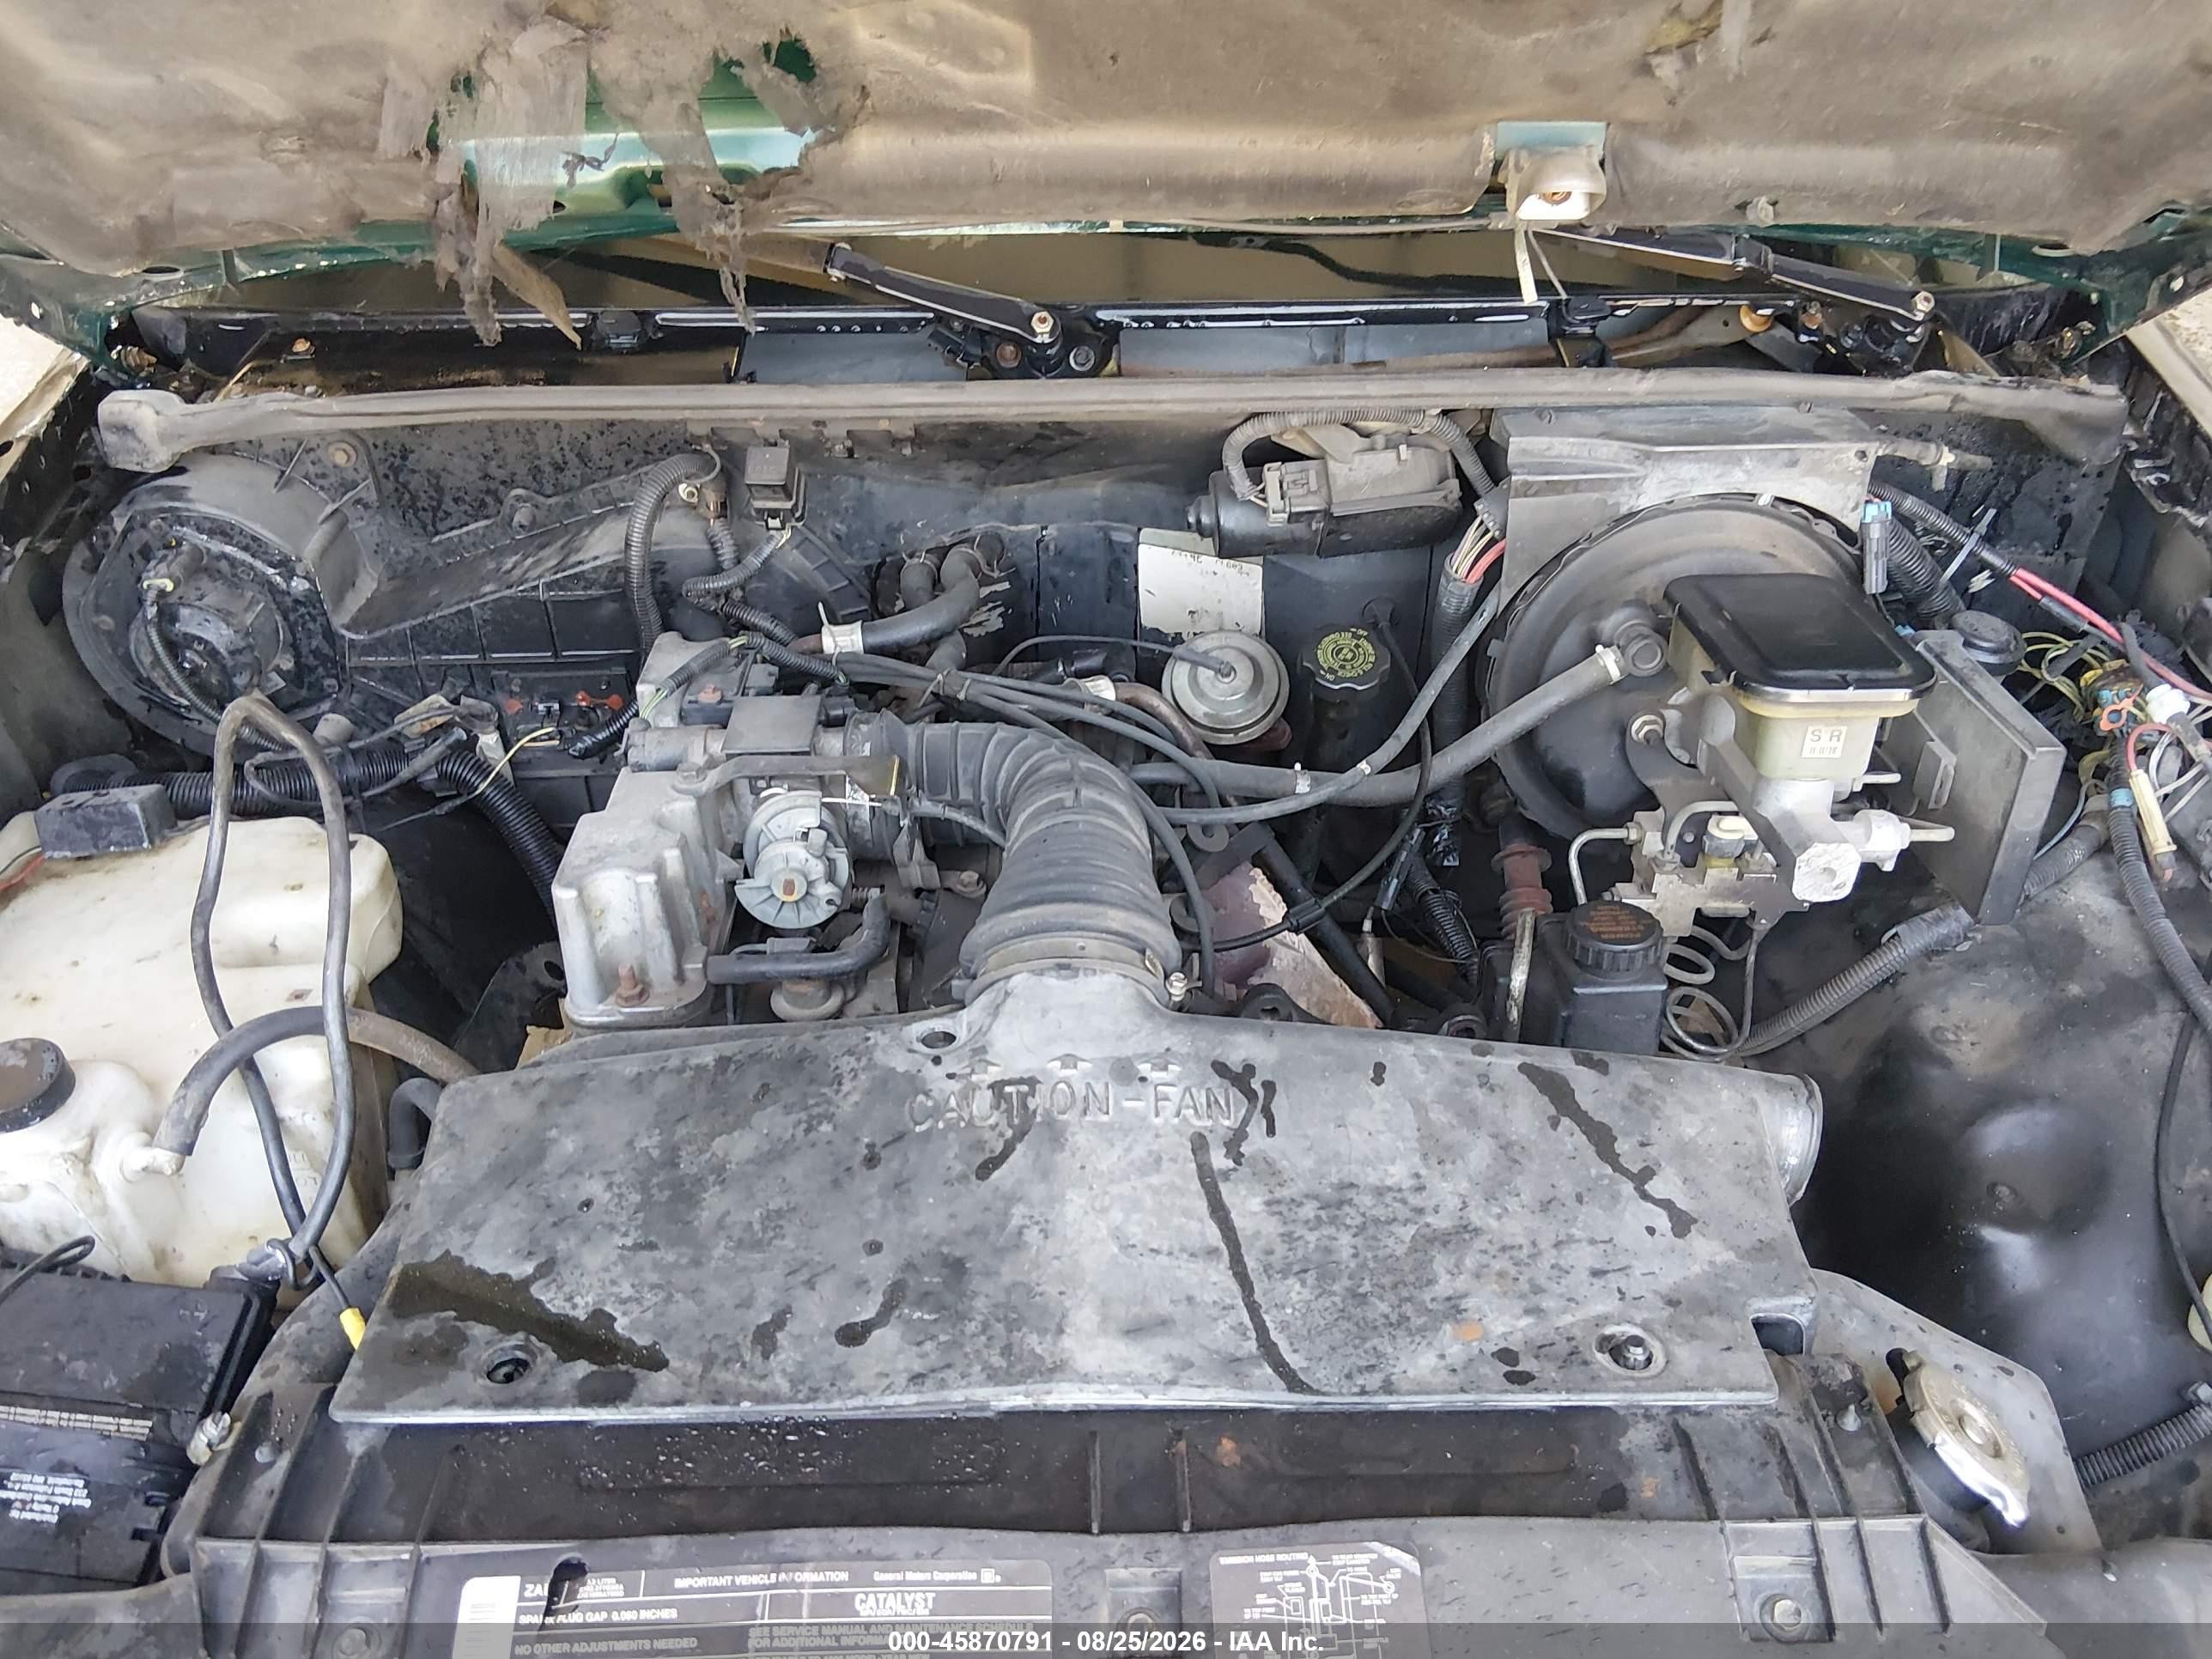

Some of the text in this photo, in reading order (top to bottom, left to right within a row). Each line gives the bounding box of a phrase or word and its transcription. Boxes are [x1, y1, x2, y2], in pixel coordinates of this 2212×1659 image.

[674, 1575, 733, 1589] IMPORTANT
[733, 1572, 777, 1586] VEHICLE
[872, 1571, 904, 1582] General
[932, 1571, 977, 1582] Corporation
[854, 1592, 937, 1612] CATALYST
[585, 1611, 608, 1623] GAP
[639, 1607, 678, 1620] INCHES
[748, 1626, 770, 1638] SEE
[772, 1625, 819, 1637] SERVICE
[821, 1623, 868, 1636] MANUAL
[514, 1636, 698, 1656] NO OTHER ADJUSTMENTS NEEDED
[748, 1637, 771, 1649] FOR
[771, 1635, 839, 1648] ADDITIONAL
